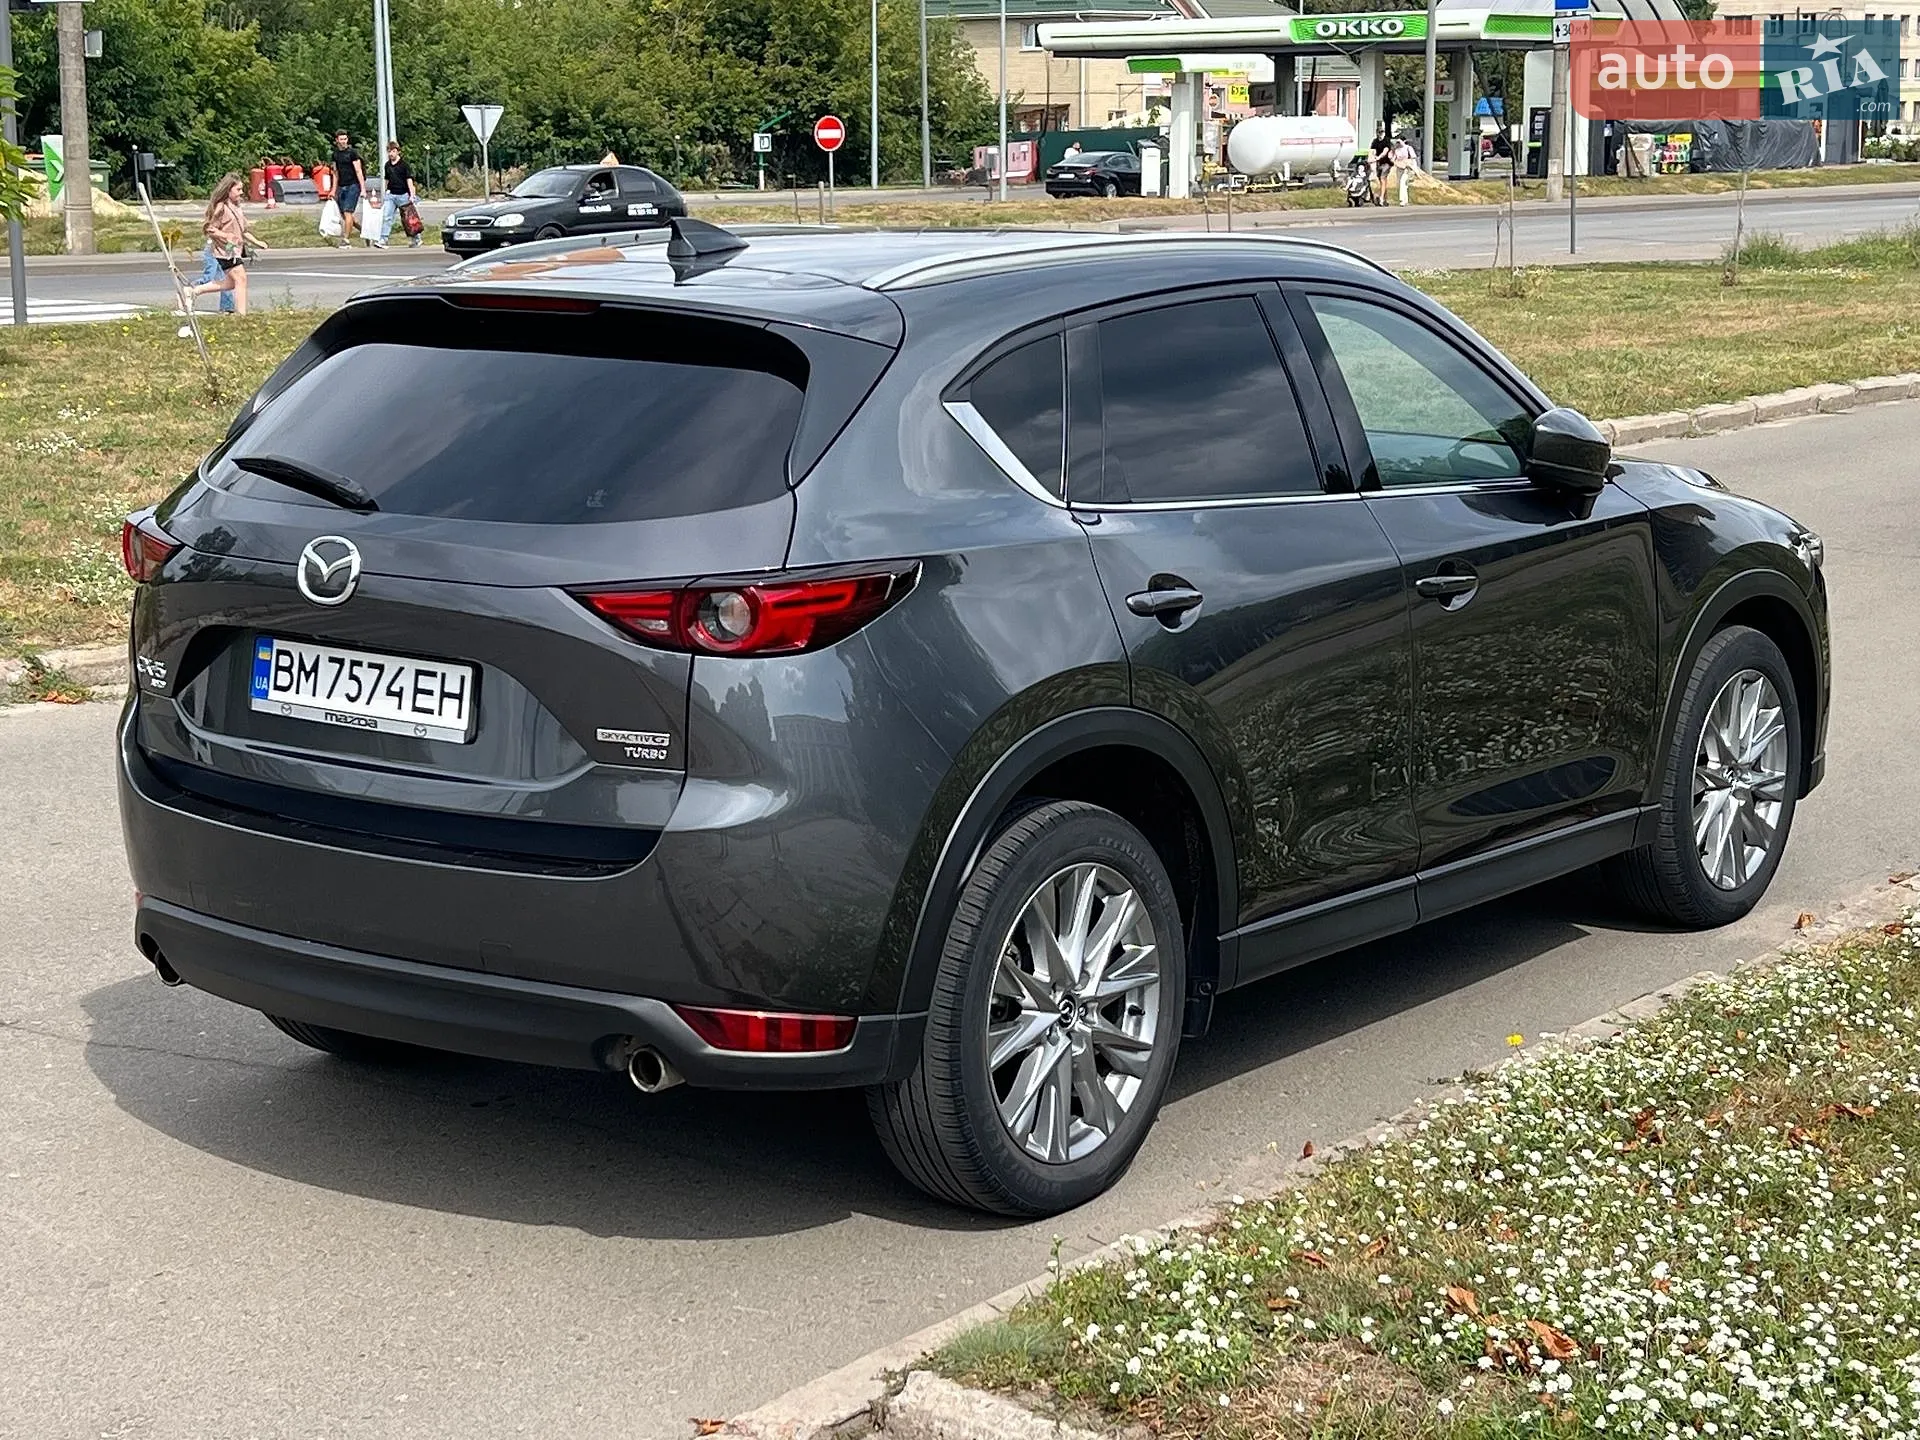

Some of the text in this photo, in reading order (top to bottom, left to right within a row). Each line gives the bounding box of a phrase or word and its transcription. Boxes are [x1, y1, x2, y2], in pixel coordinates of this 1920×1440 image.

[1315, 19, 1404, 37] OKKO
[255, 676, 268, 691] UA
[325, 711, 378, 729] mazda
[624, 746, 667, 759] TURBO
